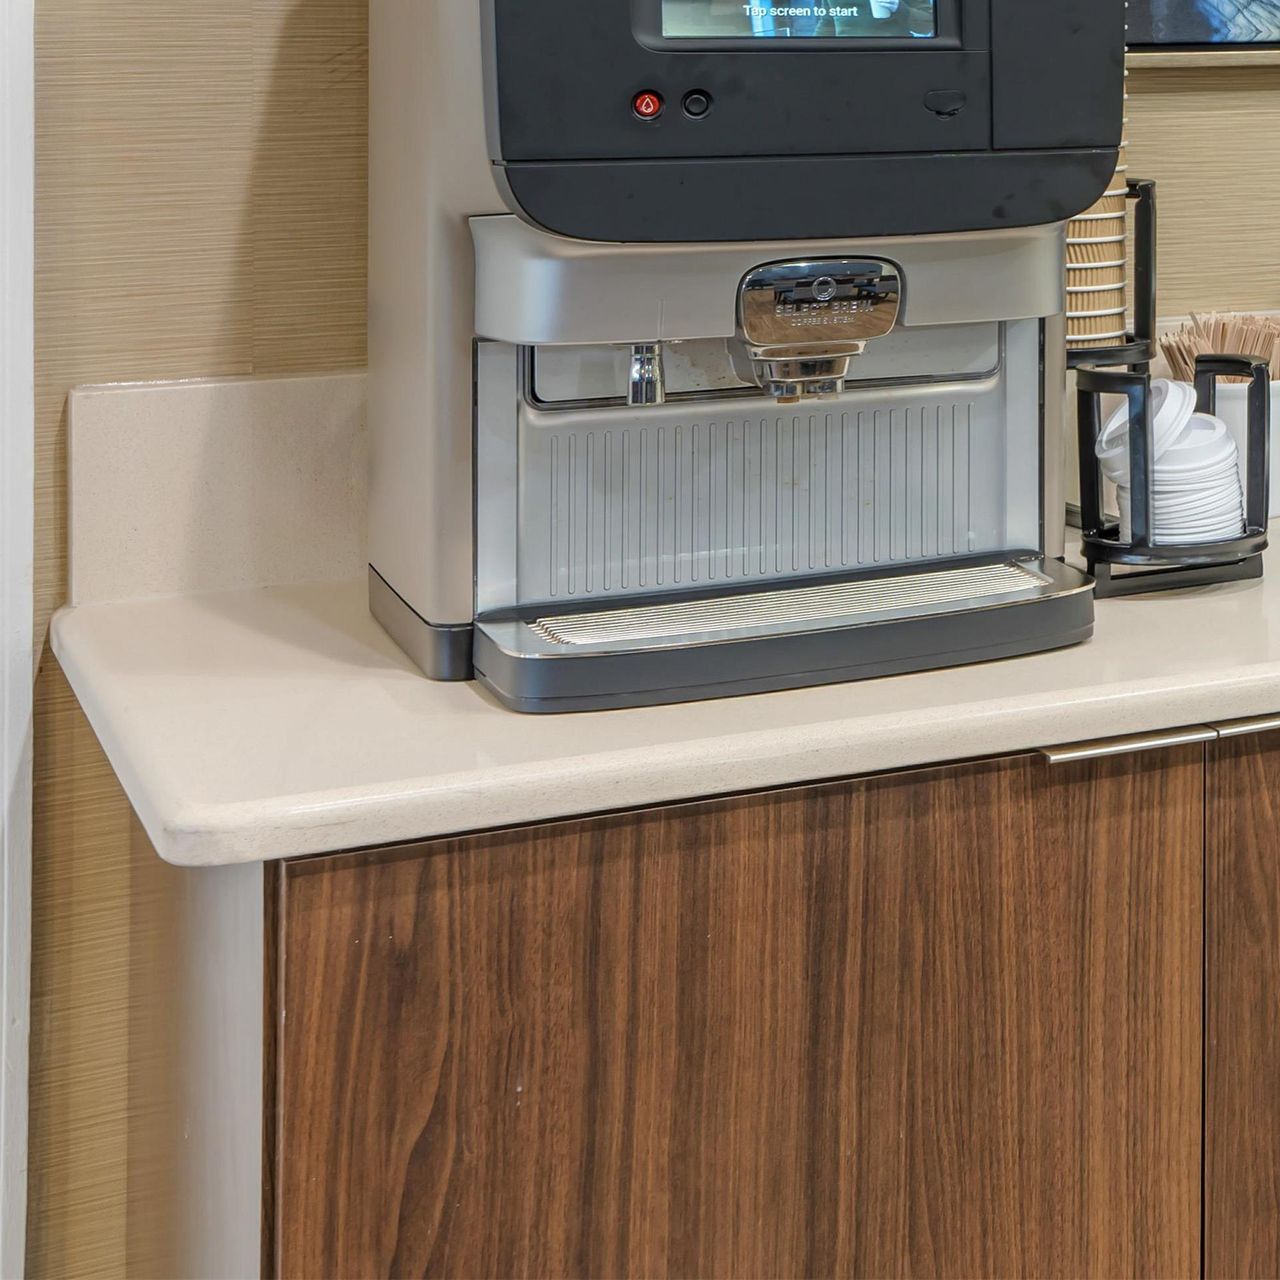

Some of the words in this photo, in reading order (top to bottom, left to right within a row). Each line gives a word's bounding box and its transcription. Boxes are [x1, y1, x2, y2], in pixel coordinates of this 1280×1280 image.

[743, 4, 767, 18] Tap
[769, 6, 811, 17] screen
[813, 6, 827, 17] to
[828, 6, 859, 17] start
